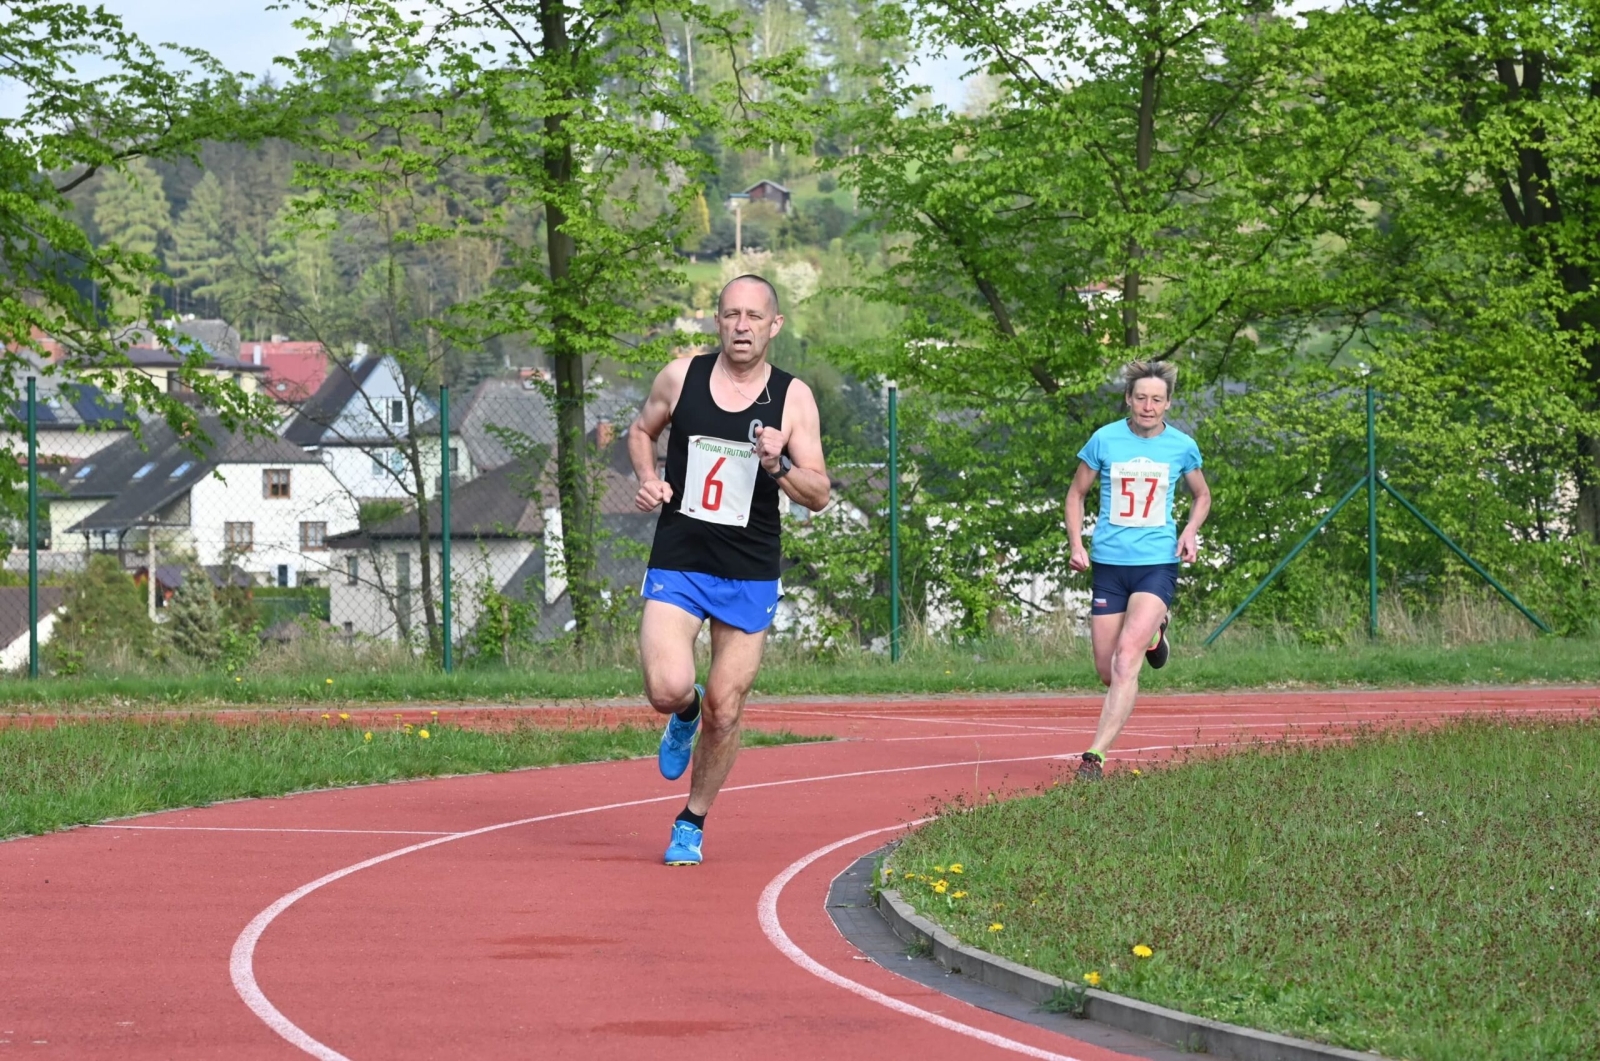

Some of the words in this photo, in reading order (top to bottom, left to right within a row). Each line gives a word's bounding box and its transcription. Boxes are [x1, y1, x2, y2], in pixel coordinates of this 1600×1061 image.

[695, 441, 722, 454] PIVOVAR
[723, 446, 753, 459] TRUTNOV
[701, 456, 727, 511] 6
[1119, 477, 1158, 518] 57
